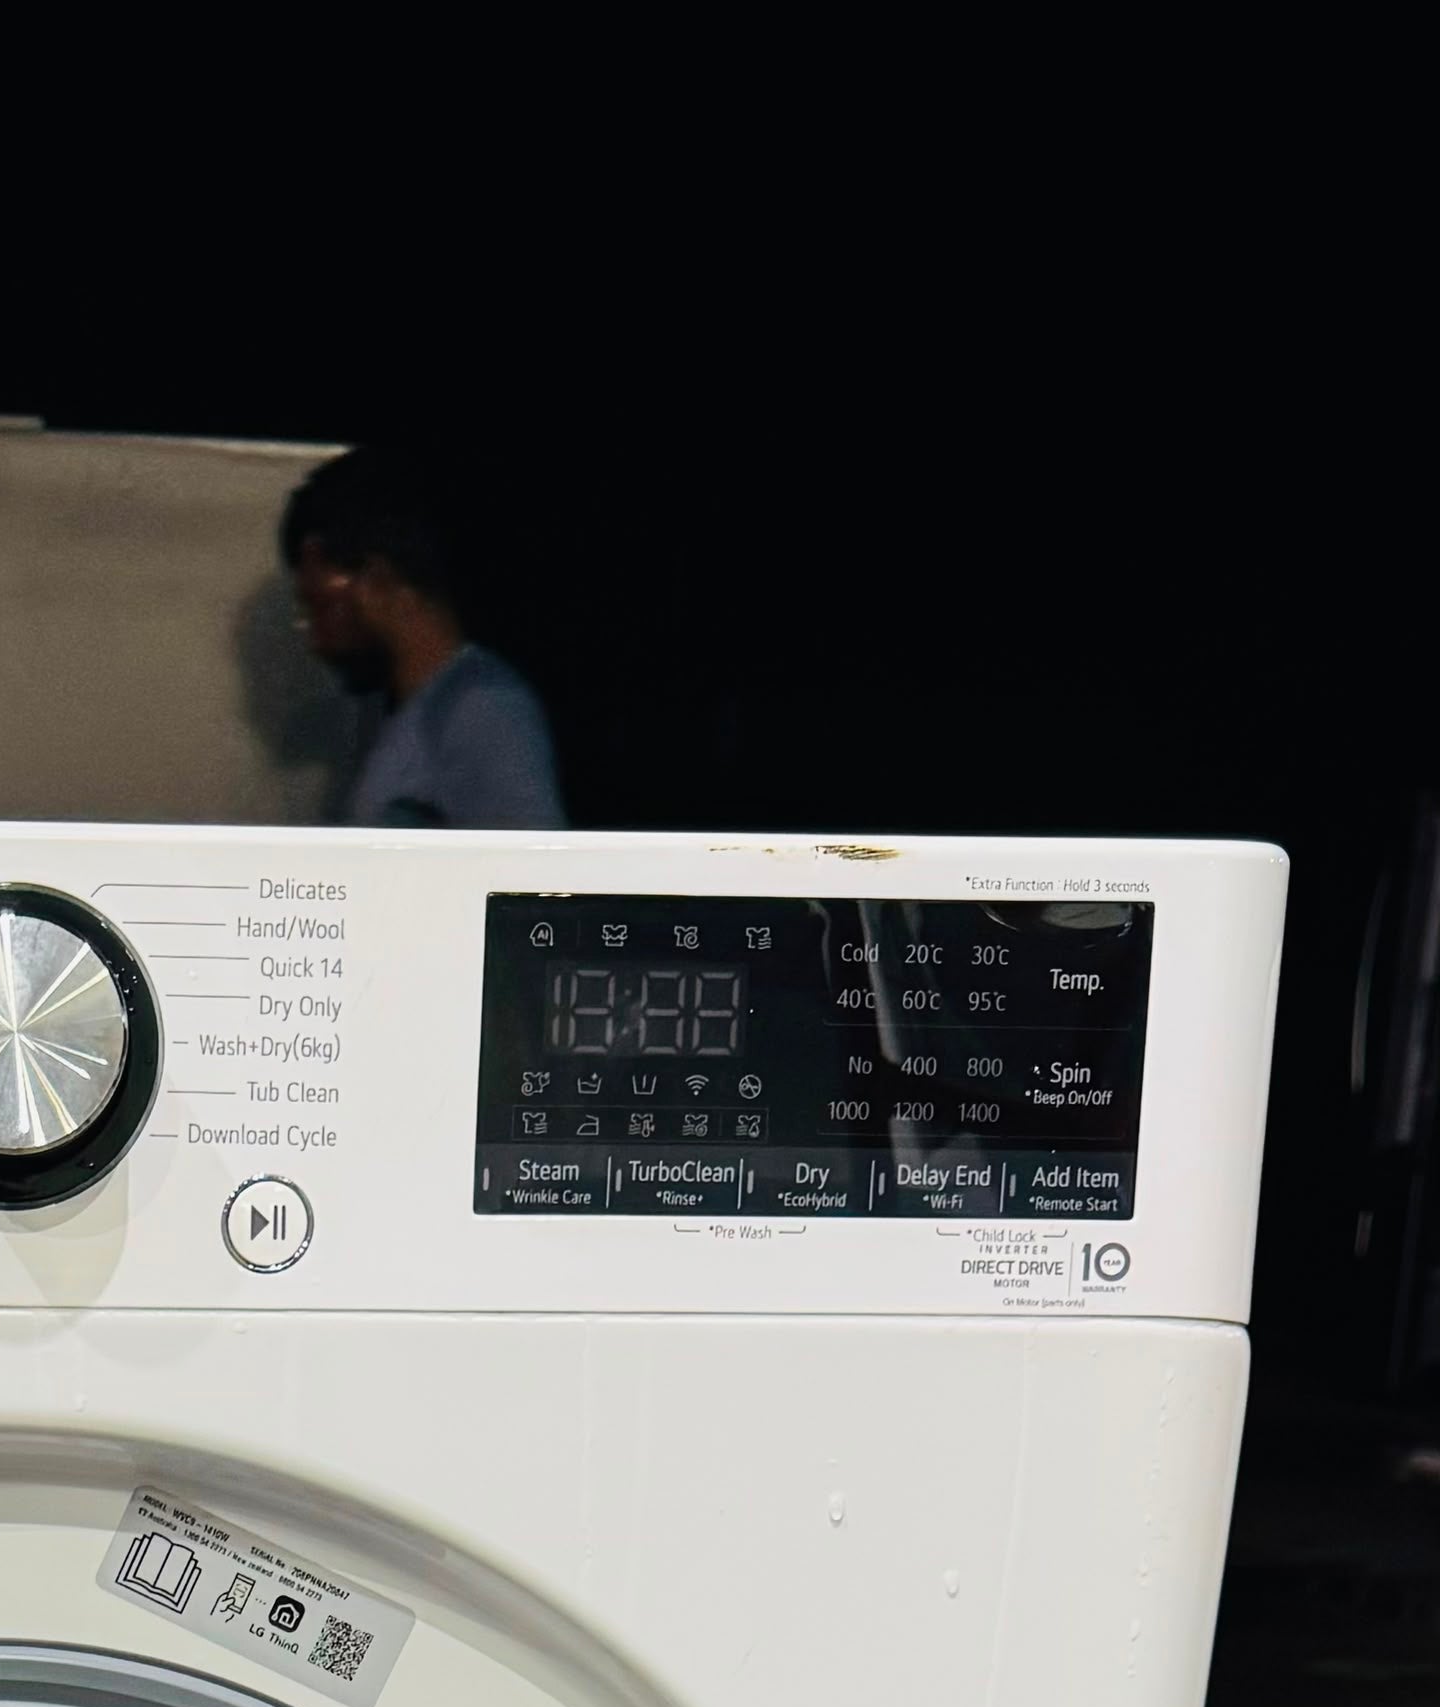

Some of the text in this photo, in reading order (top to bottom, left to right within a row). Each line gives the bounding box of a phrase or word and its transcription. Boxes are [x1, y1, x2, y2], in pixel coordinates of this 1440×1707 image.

[259, 878, 347, 900] Delicates
[1005, 877, 1053, 892] Function
[1063, 878, 1090, 892] Hold
[1093, 879, 1101, 892] 3
[1105, 879, 1150, 893] seconds
[237, 916, 345, 940] Hand/Wool
[841, 943, 879, 963] Cold
[260, 956, 343, 979] Quick 14
[1050, 968, 1104, 995] Temp.
[260, 995, 342, 1022] Dry Only
[199, 1033, 341, 1064] Wash+Dry(6kg)
[848, 1056, 1003, 1077] No 400 800
[1050, 1062, 1091, 1088] Spin
[247, 1081, 339, 1103] Tub Clean
[1068, 1090, 1112, 1107] On/Off
[828, 1101, 1000, 1123] 1000 1200 1400
[188, 1123, 337, 1152] Download Cycle
[519, 1159, 579, 1181] Steam
[628, 1160, 734, 1183] TurboClean
[796, 1163, 829, 1191] Dry
[897, 1163, 991, 1191] Delay End
[1032, 1166, 1119, 1189] Add Item
[562, 1190, 591, 1205] Care
[1086, 1197, 1117, 1212] Start
[739, 1225, 771, 1239] Wash
[1009, 1230, 1035, 1243] Lock
[979, 1245, 1048, 1254] INVERTER
[961, 1260, 1064, 1276] DIRECT DRIVE
[1081, 1242, 1131, 1282] 10
[993, 1279, 1029, 1288] MOTOR
[249, 1623, 299, 1655] LG ThinQ
